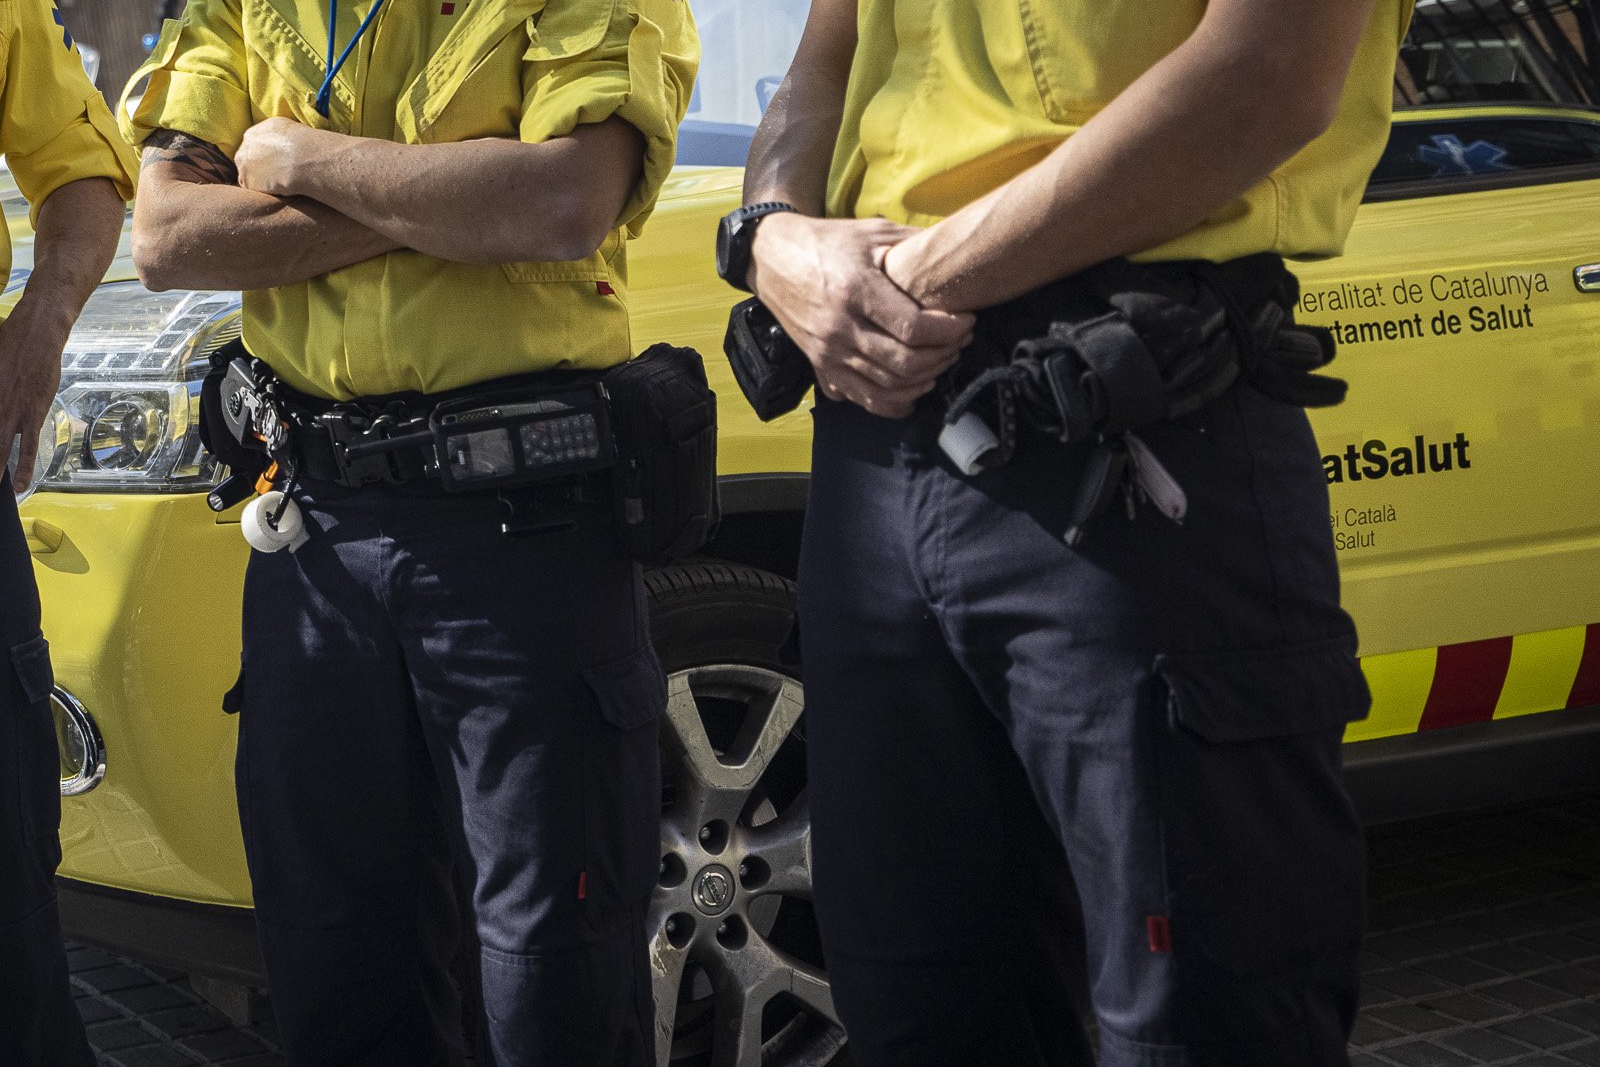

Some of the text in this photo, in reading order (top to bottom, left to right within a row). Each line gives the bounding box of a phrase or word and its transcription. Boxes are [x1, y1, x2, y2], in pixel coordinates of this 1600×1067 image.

[1392, 278, 1424, 306] de
[1430, 271, 1550, 303] Catalunya
[1431, 309, 1462, 335] de
[1469, 303, 1534, 333] Salut
[1321, 432, 1472, 485] atSalut
[1344, 504, 1397, 527] Català
[1335, 531, 1376, 551] Salut
